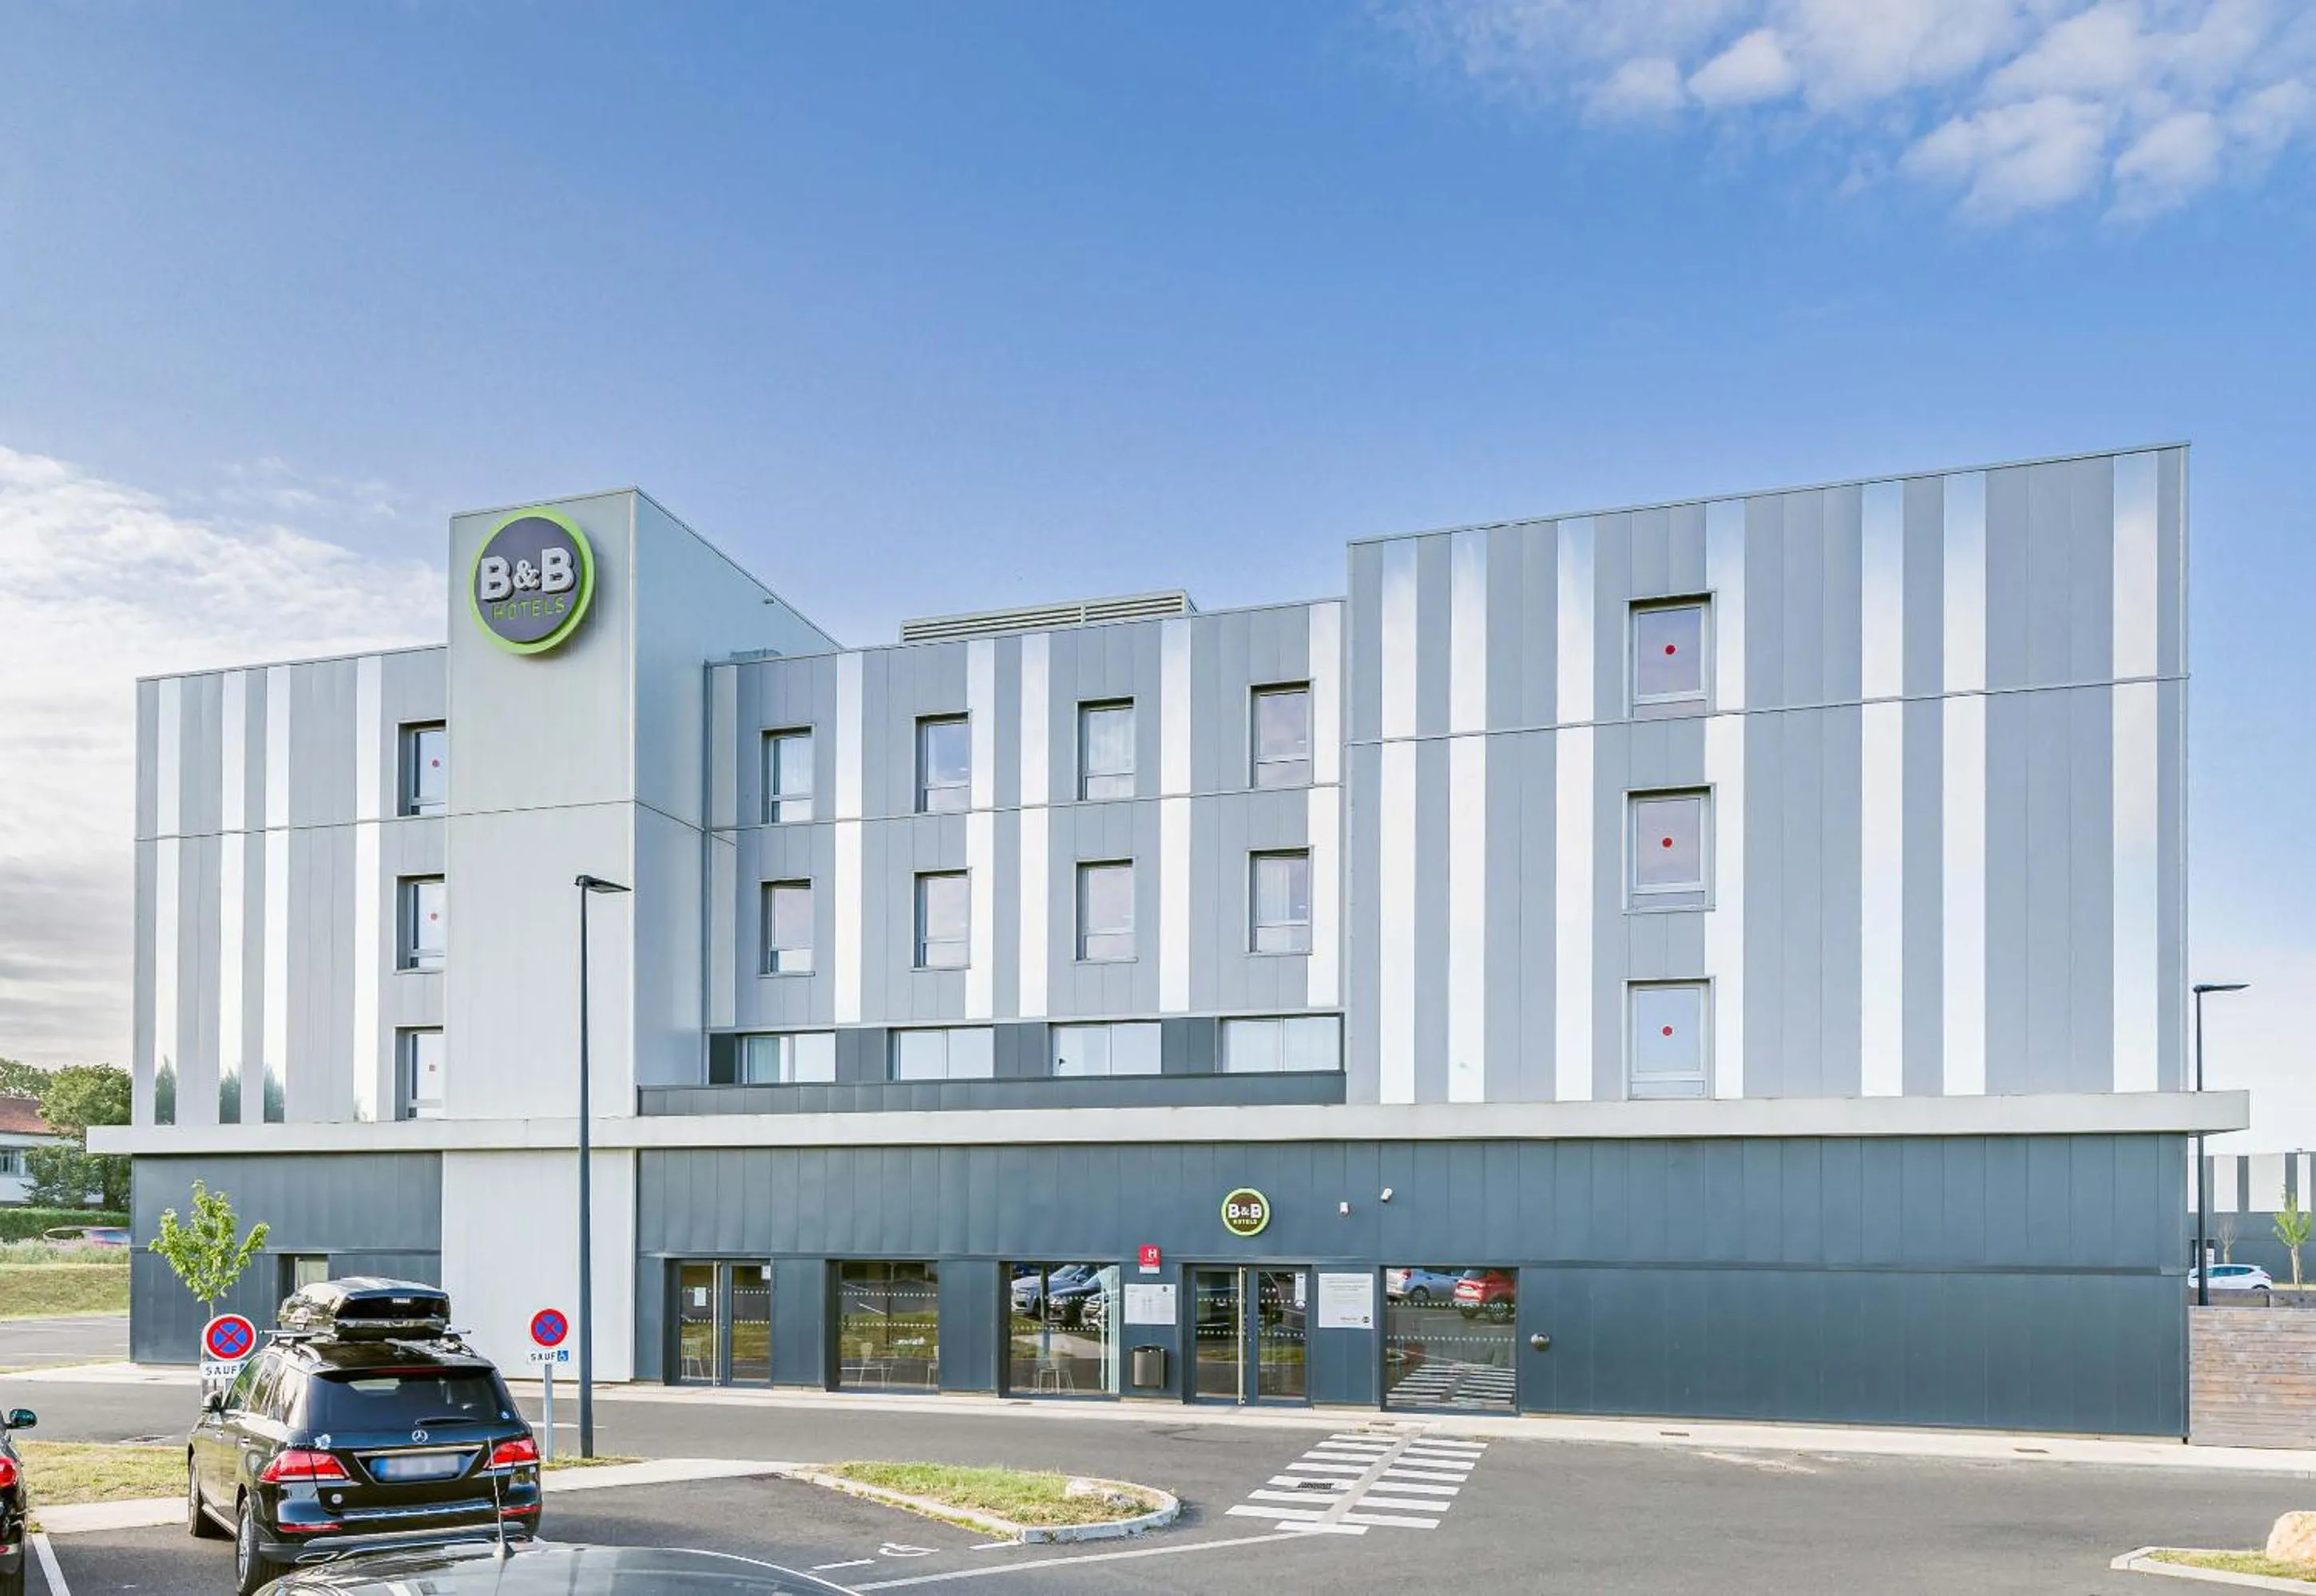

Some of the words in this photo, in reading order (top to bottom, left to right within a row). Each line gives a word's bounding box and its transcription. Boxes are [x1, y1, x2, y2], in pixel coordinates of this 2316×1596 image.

[482, 548, 575, 600] B&B
[492, 597, 565, 620] HOTELS
[1227, 1203, 1262, 1218] B&B
[530, 1352, 557, 1361] SAUF
[205, 1365, 237, 1376] SAUF
